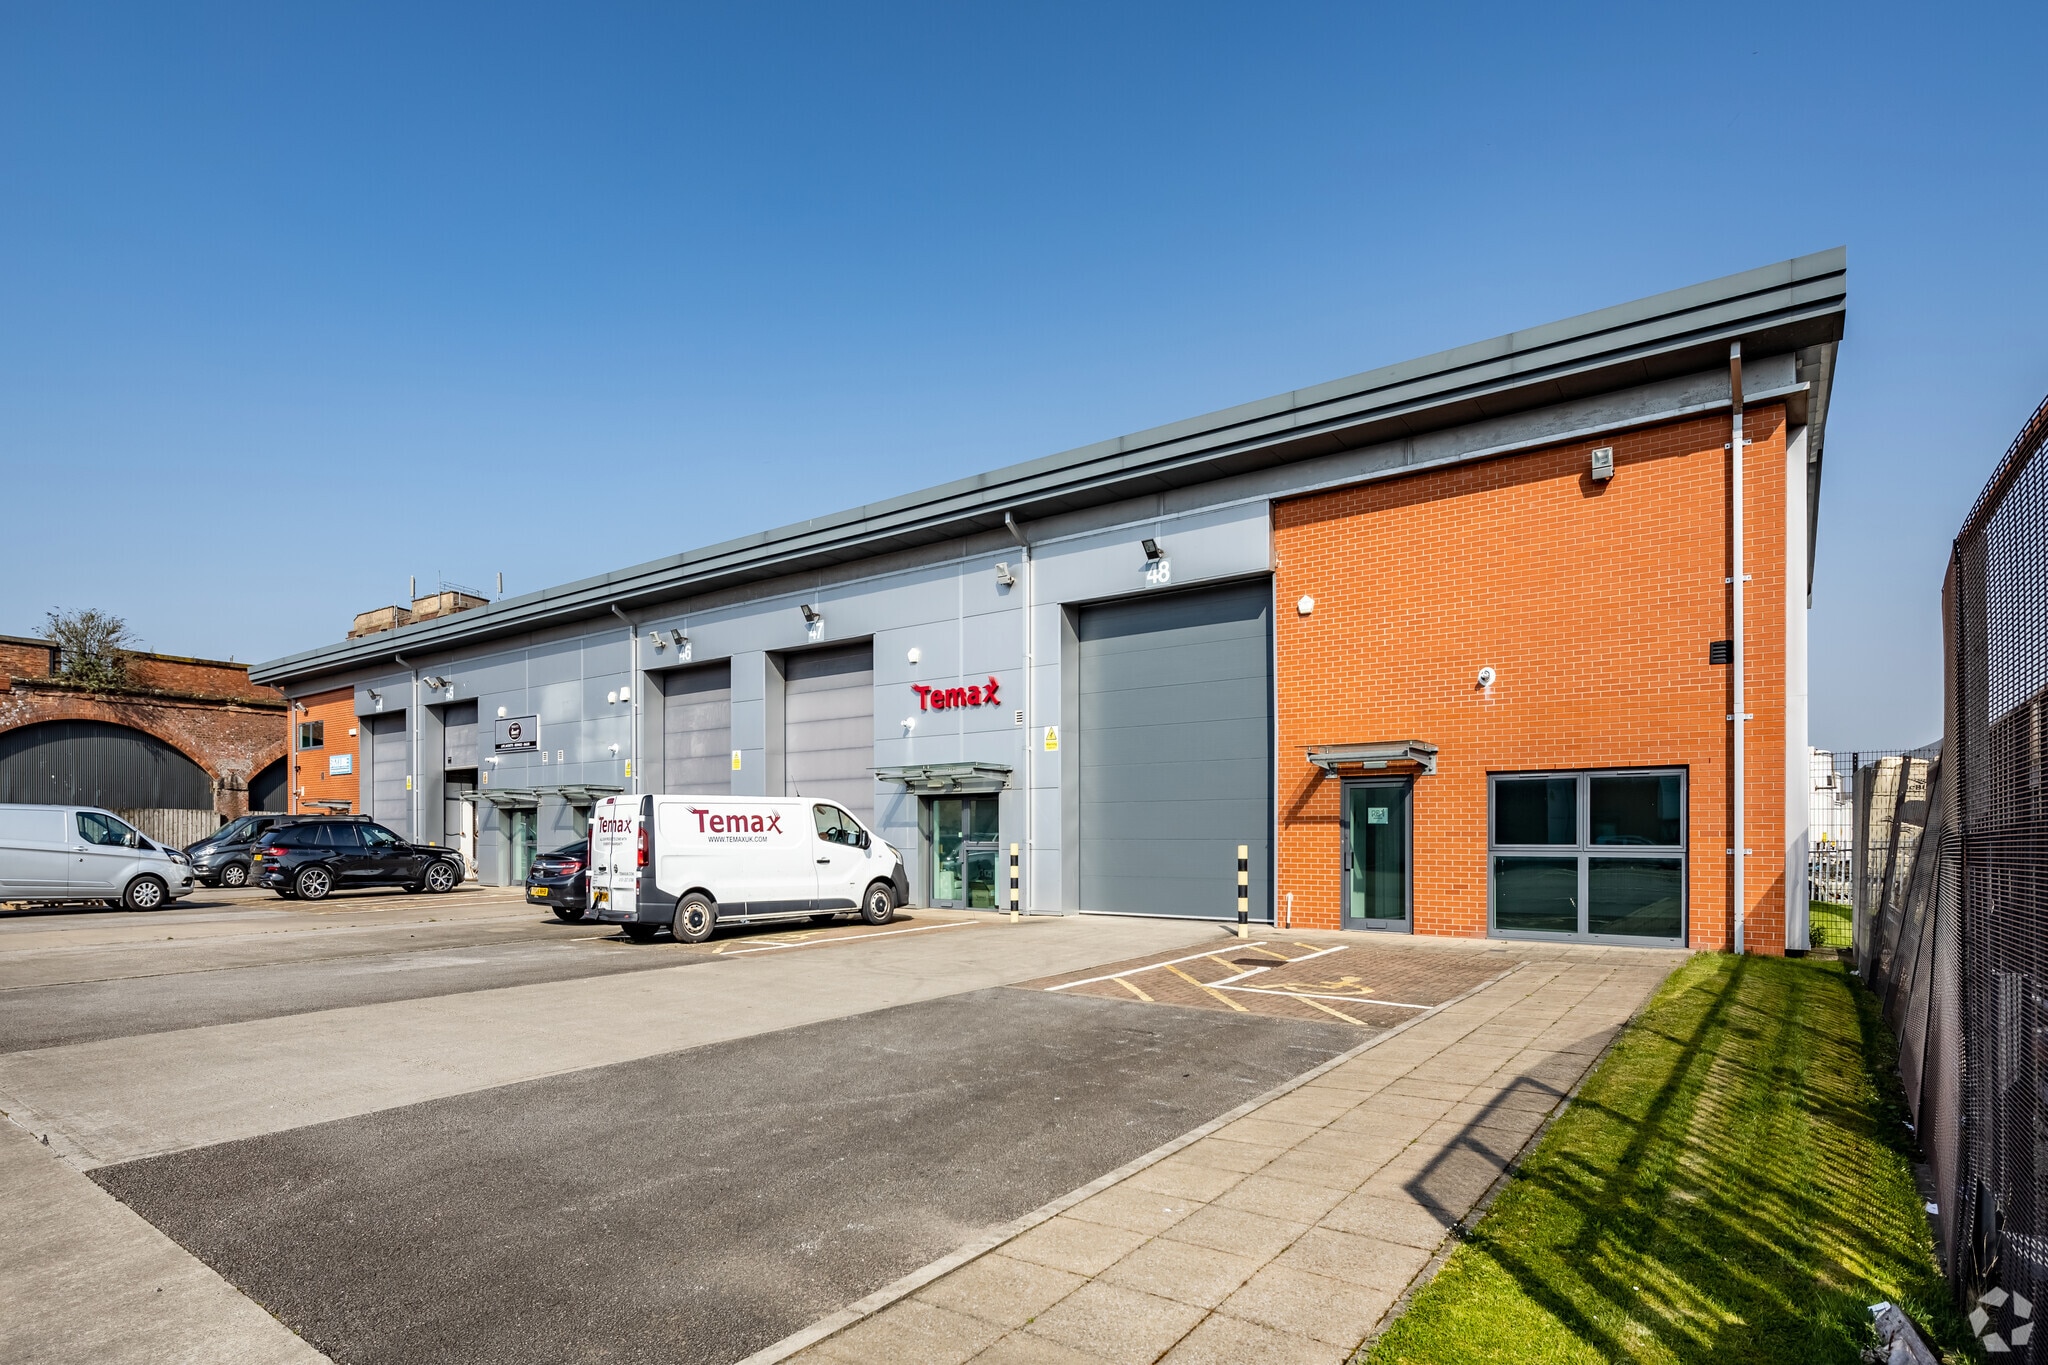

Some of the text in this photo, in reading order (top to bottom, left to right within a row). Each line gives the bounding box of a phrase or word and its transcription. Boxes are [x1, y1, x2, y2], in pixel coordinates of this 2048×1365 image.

[1147, 561, 1170, 584] 48
[809, 621, 823, 639] 47
[679, 645, 691, 660] 46
[911, 676, 1001, 711] Temax
[598, 816, 632, 833] Temax
[684, 805, 783, 834] Temax
